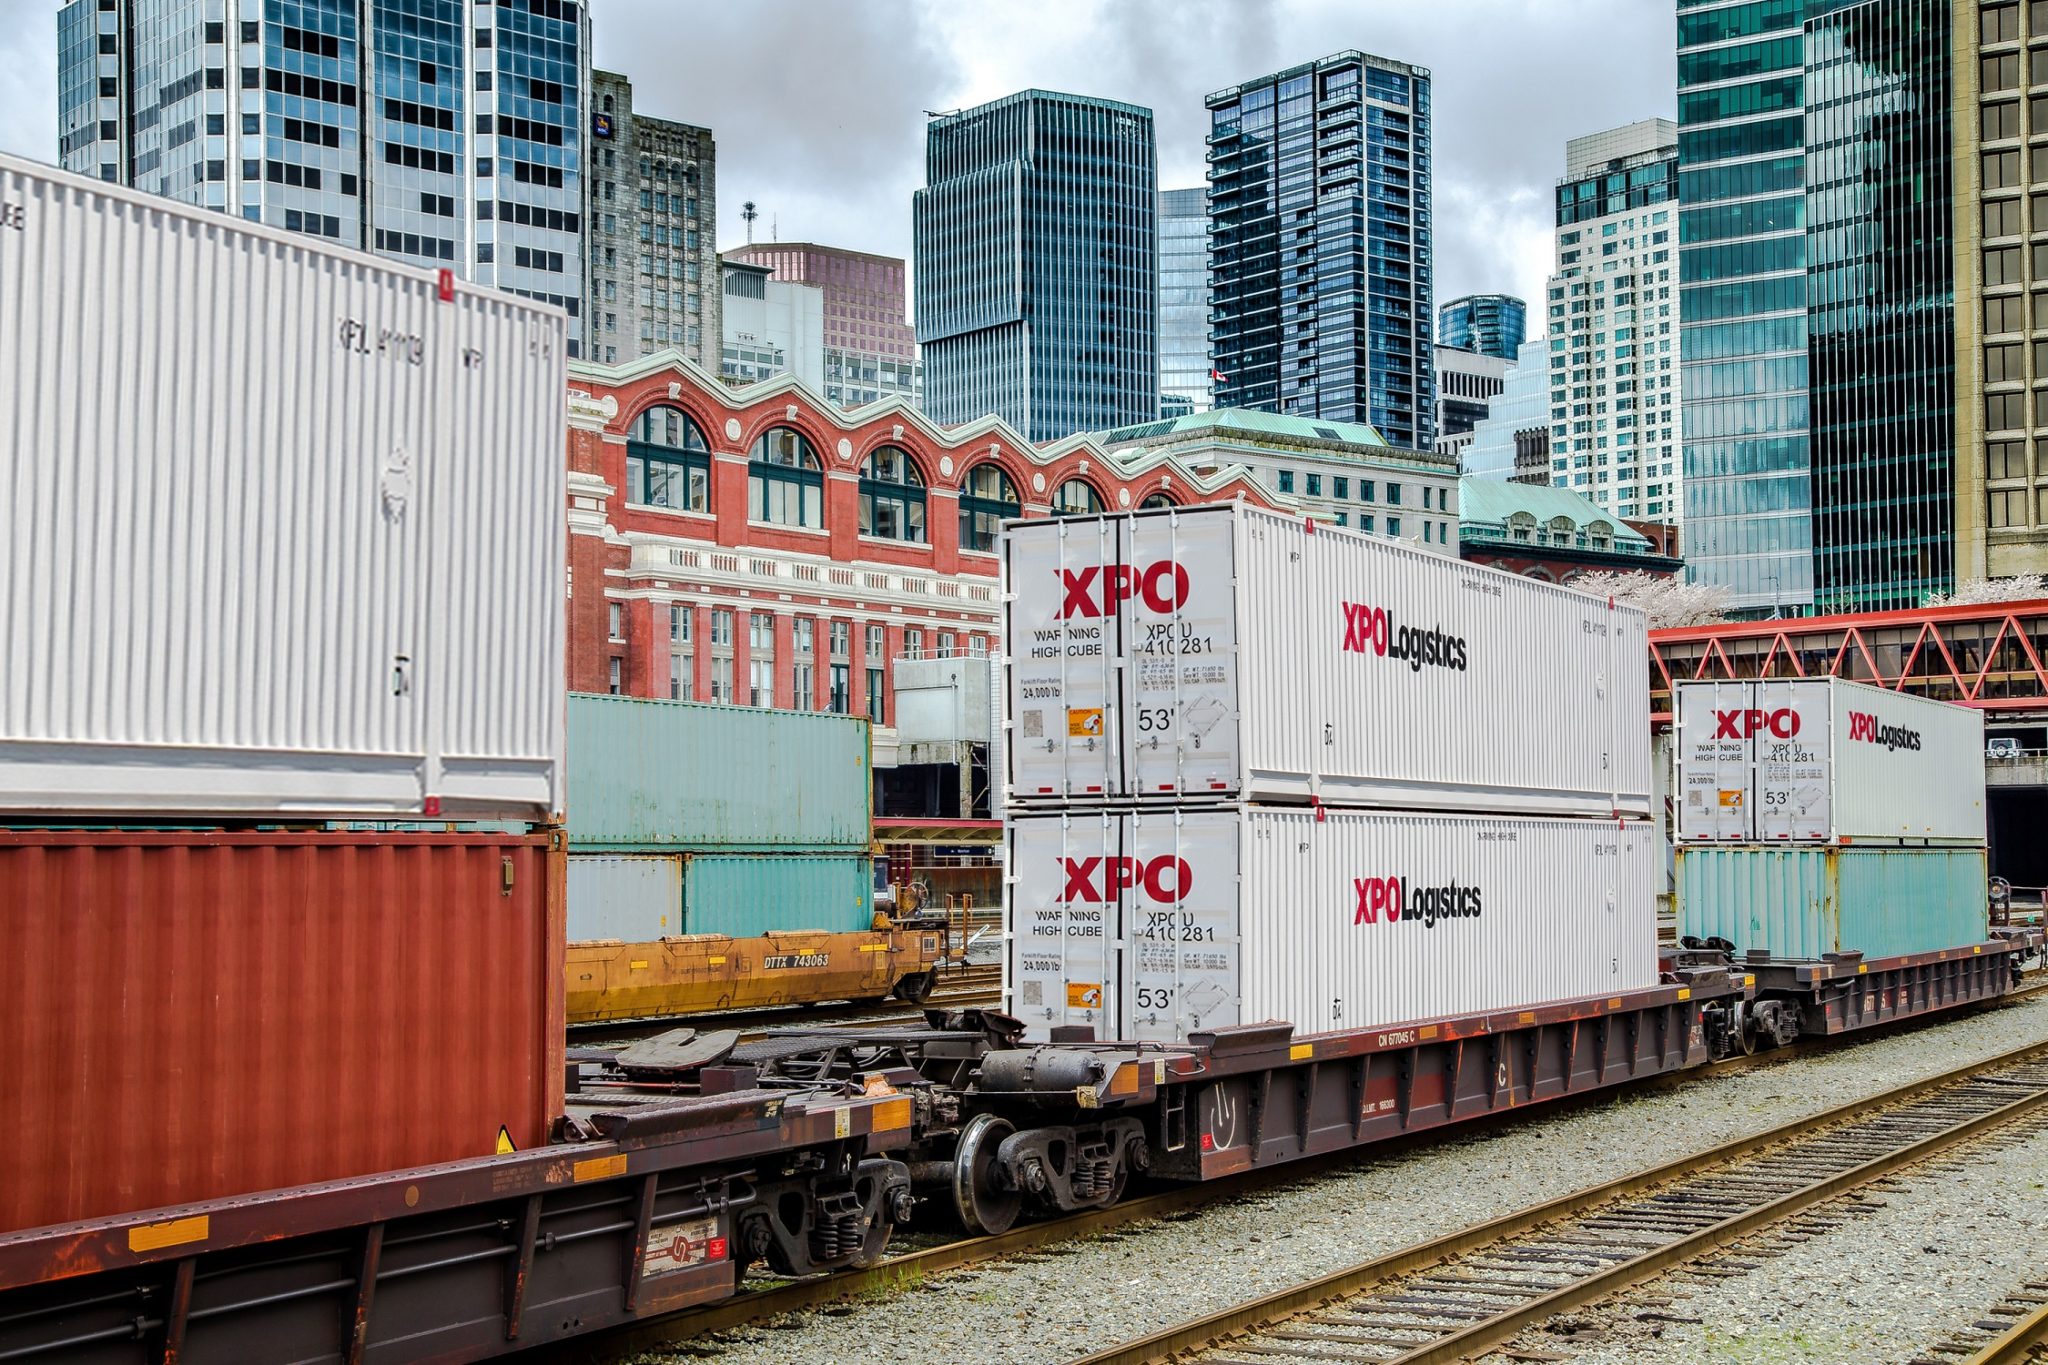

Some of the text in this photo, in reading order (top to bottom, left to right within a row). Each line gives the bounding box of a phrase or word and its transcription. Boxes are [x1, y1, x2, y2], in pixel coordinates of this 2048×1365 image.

[1053, 560, 1190, 620] XPO
[1032, 643, 1102, 659] HIGH CUBE
[1139, 708, 1174, 731] 53'
[1710, 708, 1801, 740] XPO
[1695, 753, 1742, 762] HIGH CUBE
[1765, 791, 1790, 805] 53'
[1055, 854, 1193, 904] XPO
[1032, 926, 1102, 937] HIGH CUBE
[764, 954, 829, 969] DTTX 743063
[1137, 988, 1174, 1009] 53'
[1378, 1031, 1415, 1047] CN 677045 C
[1498, 1063, 1506, 1087] C
